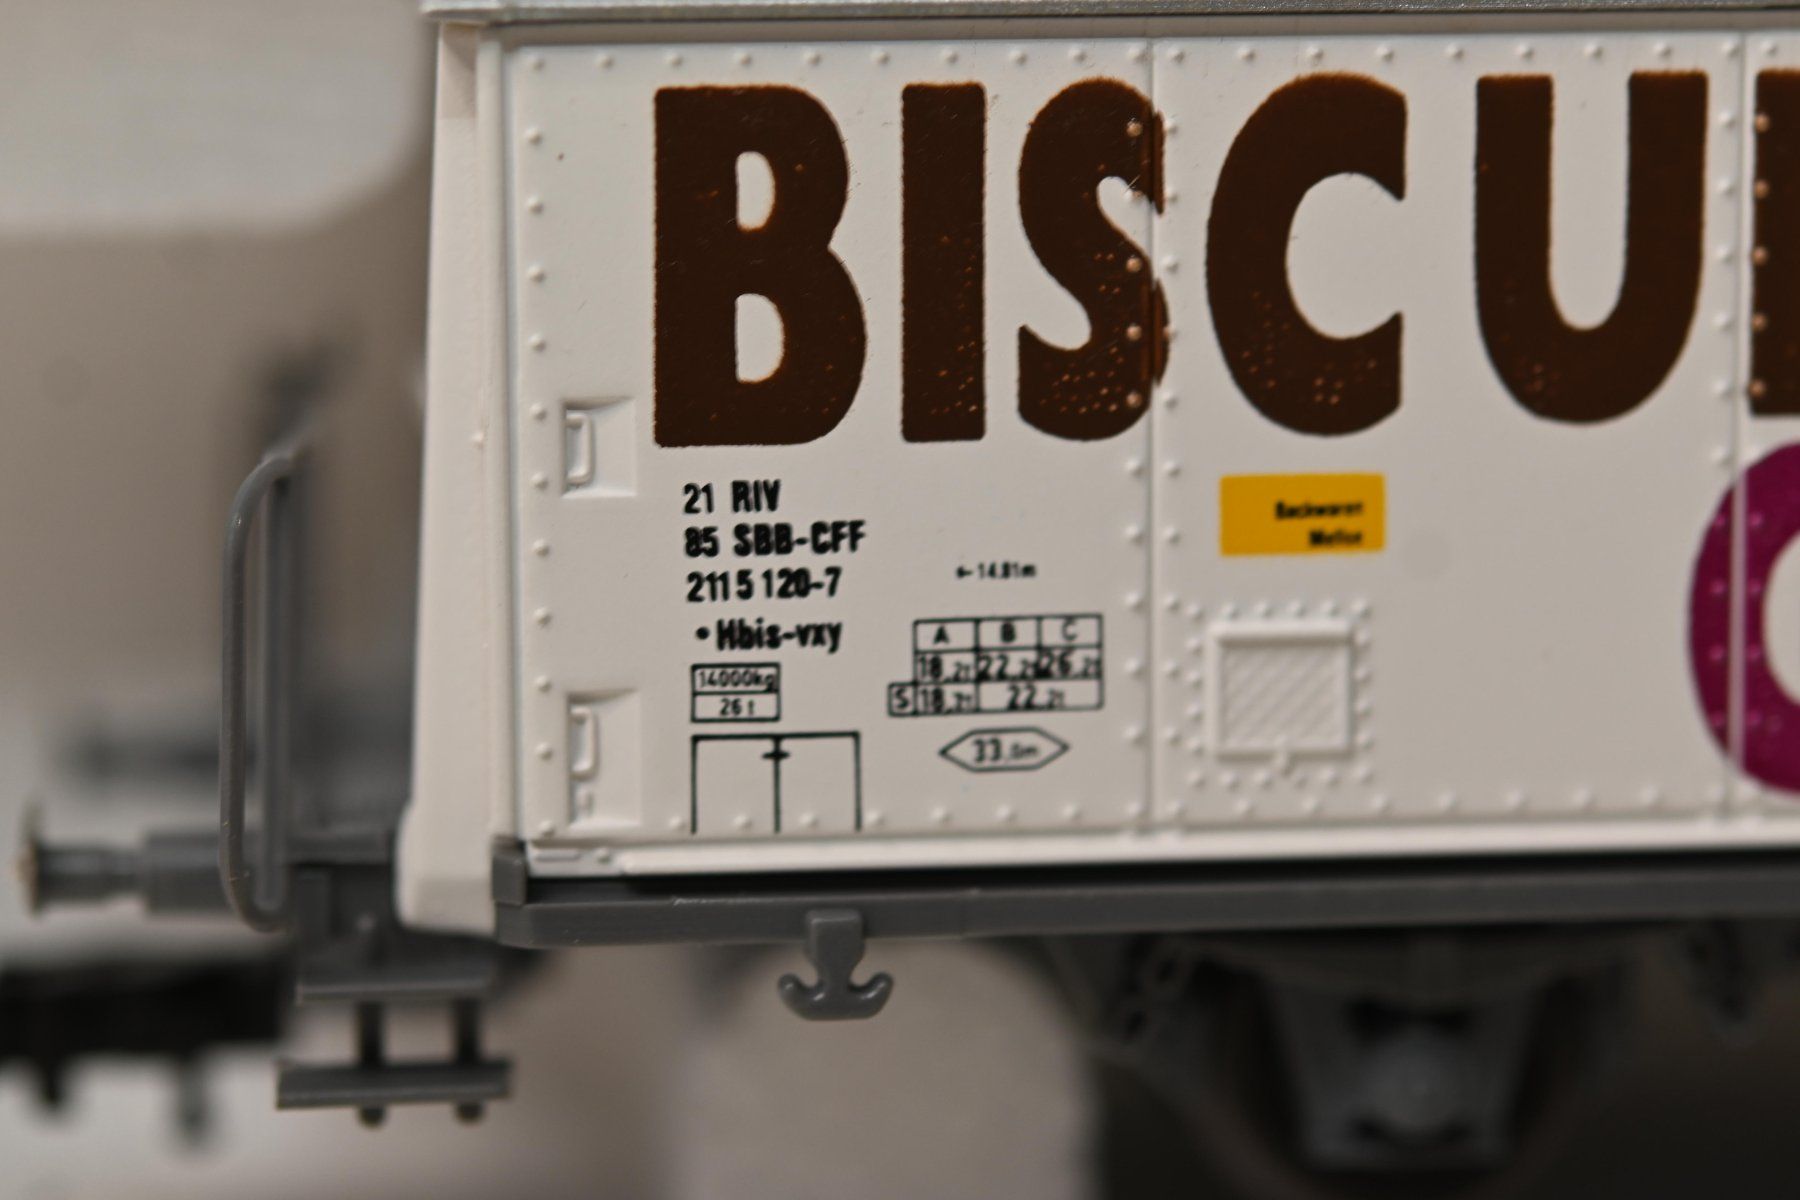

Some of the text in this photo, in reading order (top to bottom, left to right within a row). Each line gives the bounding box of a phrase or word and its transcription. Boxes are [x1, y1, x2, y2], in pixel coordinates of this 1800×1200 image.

[683, 479, 780, 514] 21 RIV
[684, 520, 866, 557] 85 SBB-CFF
[933, 618, 1077, 644] A B C
[698, 669, 776, 692] 14000kg
[895, 689, 909, 709] S
